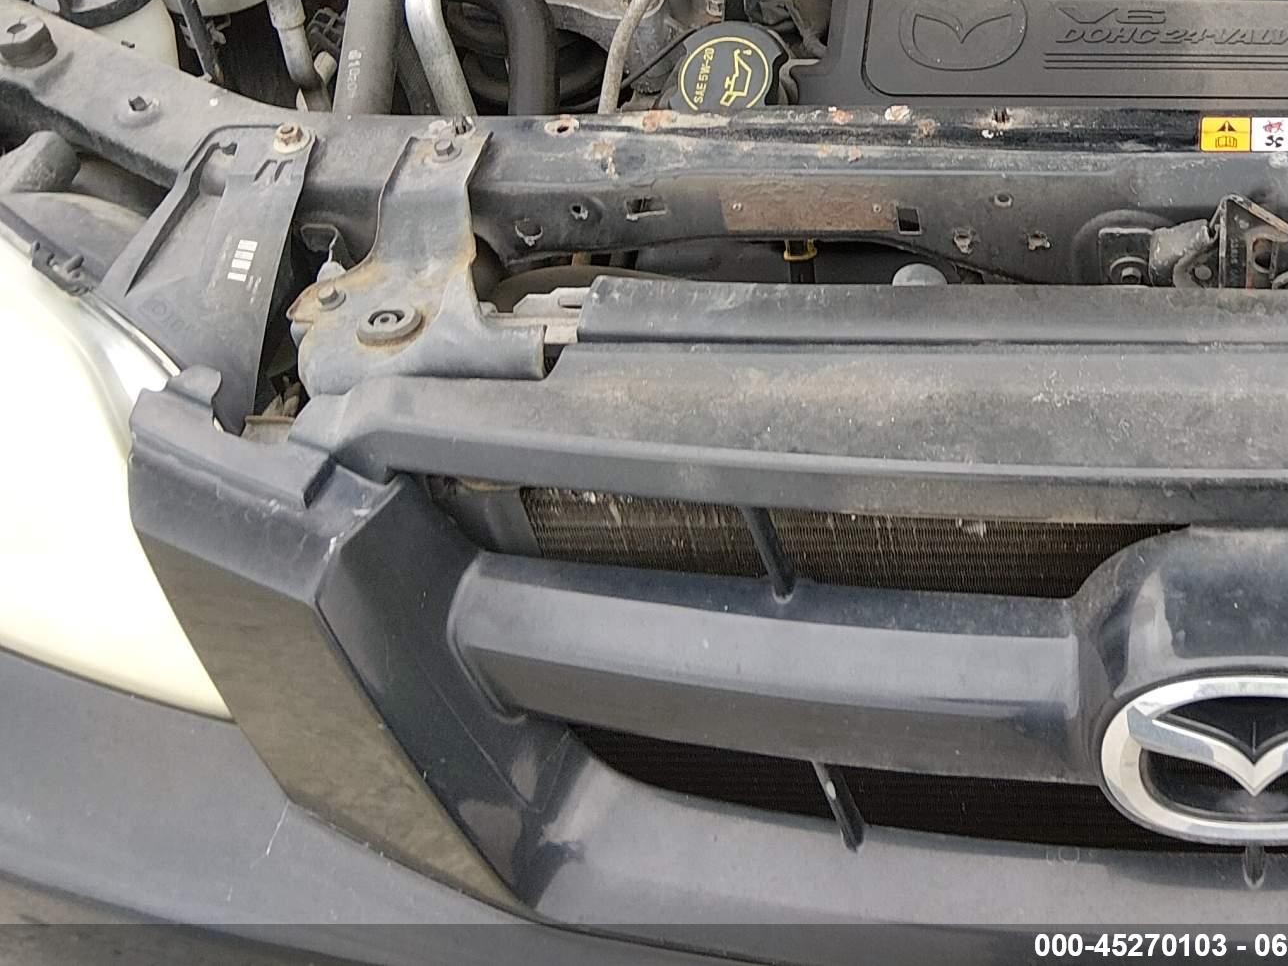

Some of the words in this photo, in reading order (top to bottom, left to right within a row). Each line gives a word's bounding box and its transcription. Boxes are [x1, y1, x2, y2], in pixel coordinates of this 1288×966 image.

[1058, 7, 1167, 24] V6
[1055, 27, 1160, 44] DOHC
[699, 47, 715, 82] 5W-20
[694, 83, 707, 104] SAE
